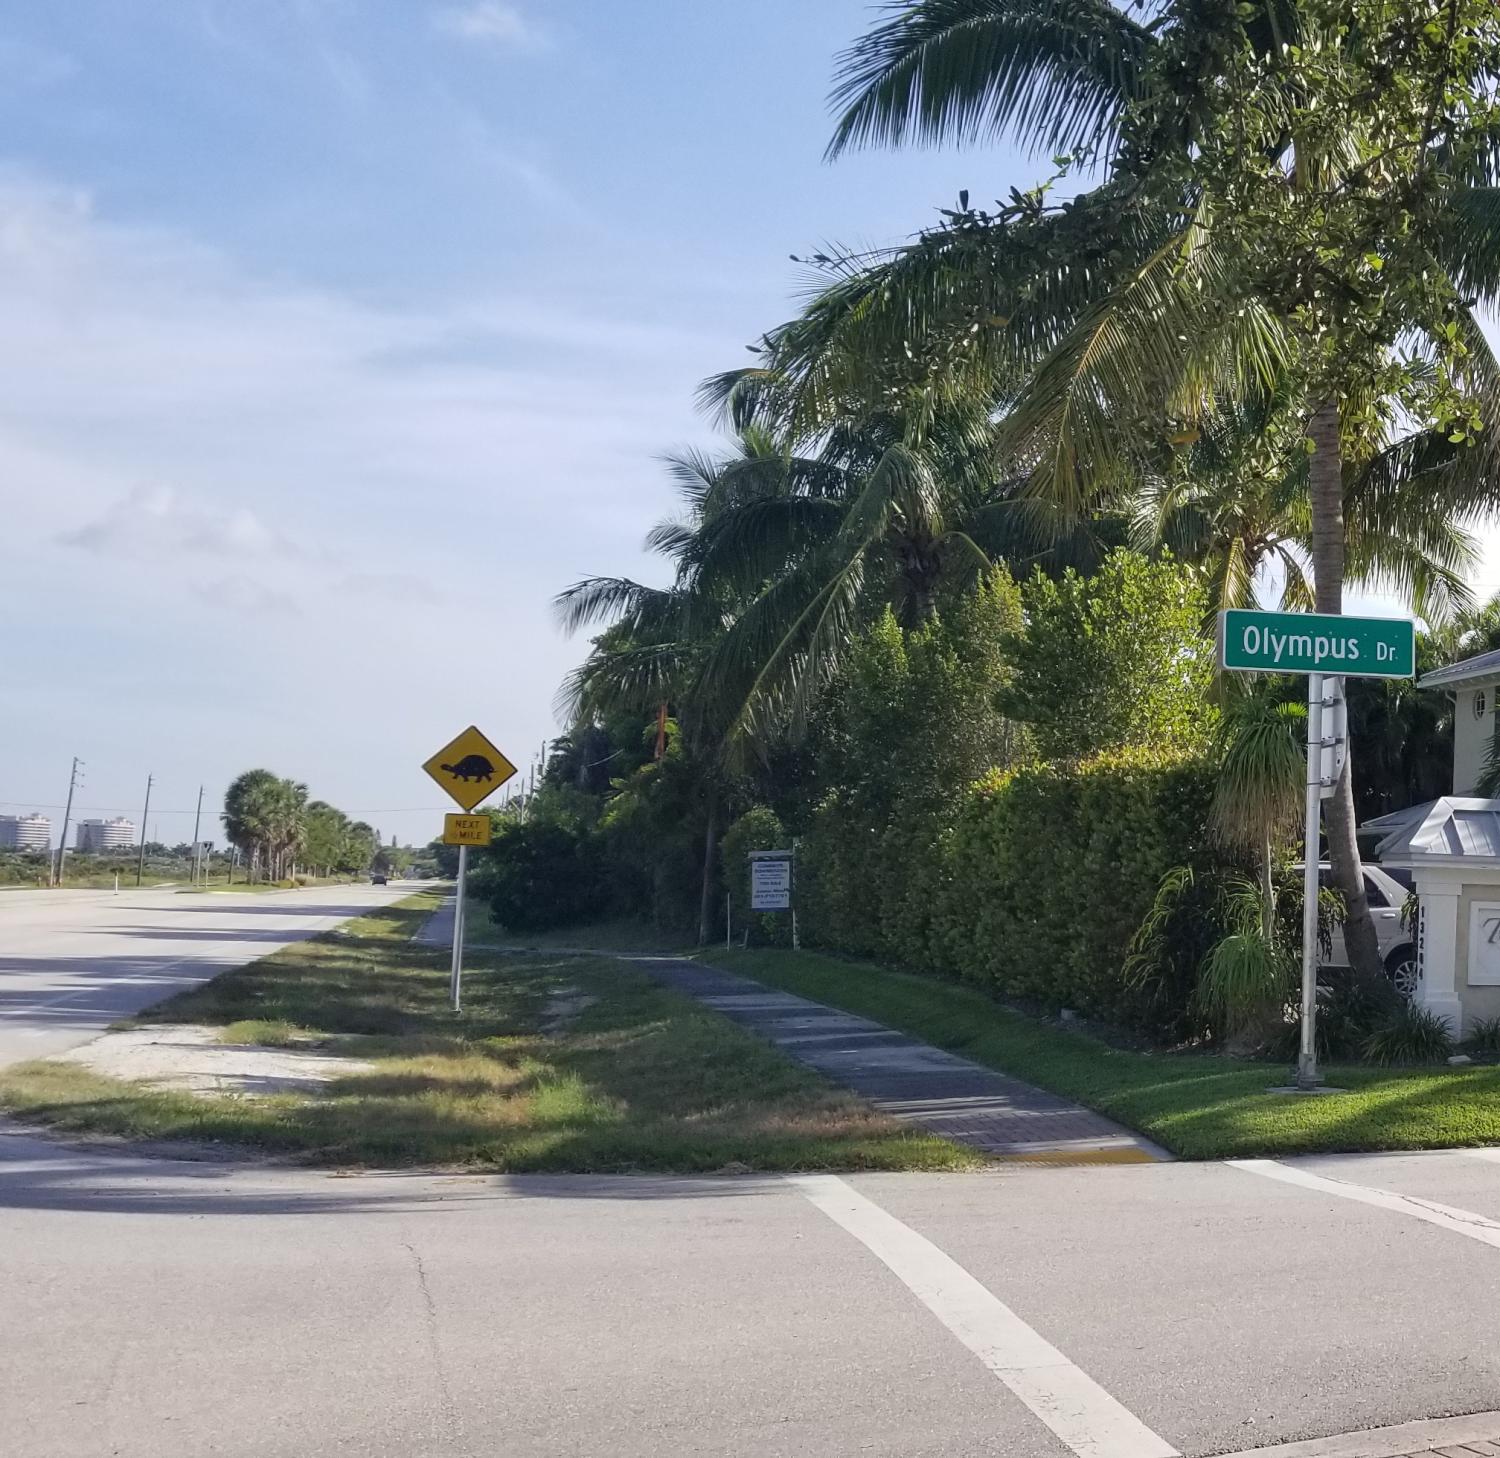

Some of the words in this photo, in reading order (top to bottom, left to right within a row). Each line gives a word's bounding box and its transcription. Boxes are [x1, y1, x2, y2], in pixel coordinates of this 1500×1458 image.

[1243, 625, 1360, 664] Olympus
[1376, 641, 1396, 662] Dr
[455, 820, 480, 828] NEXT
[459, 831, 482, 840] MILE
